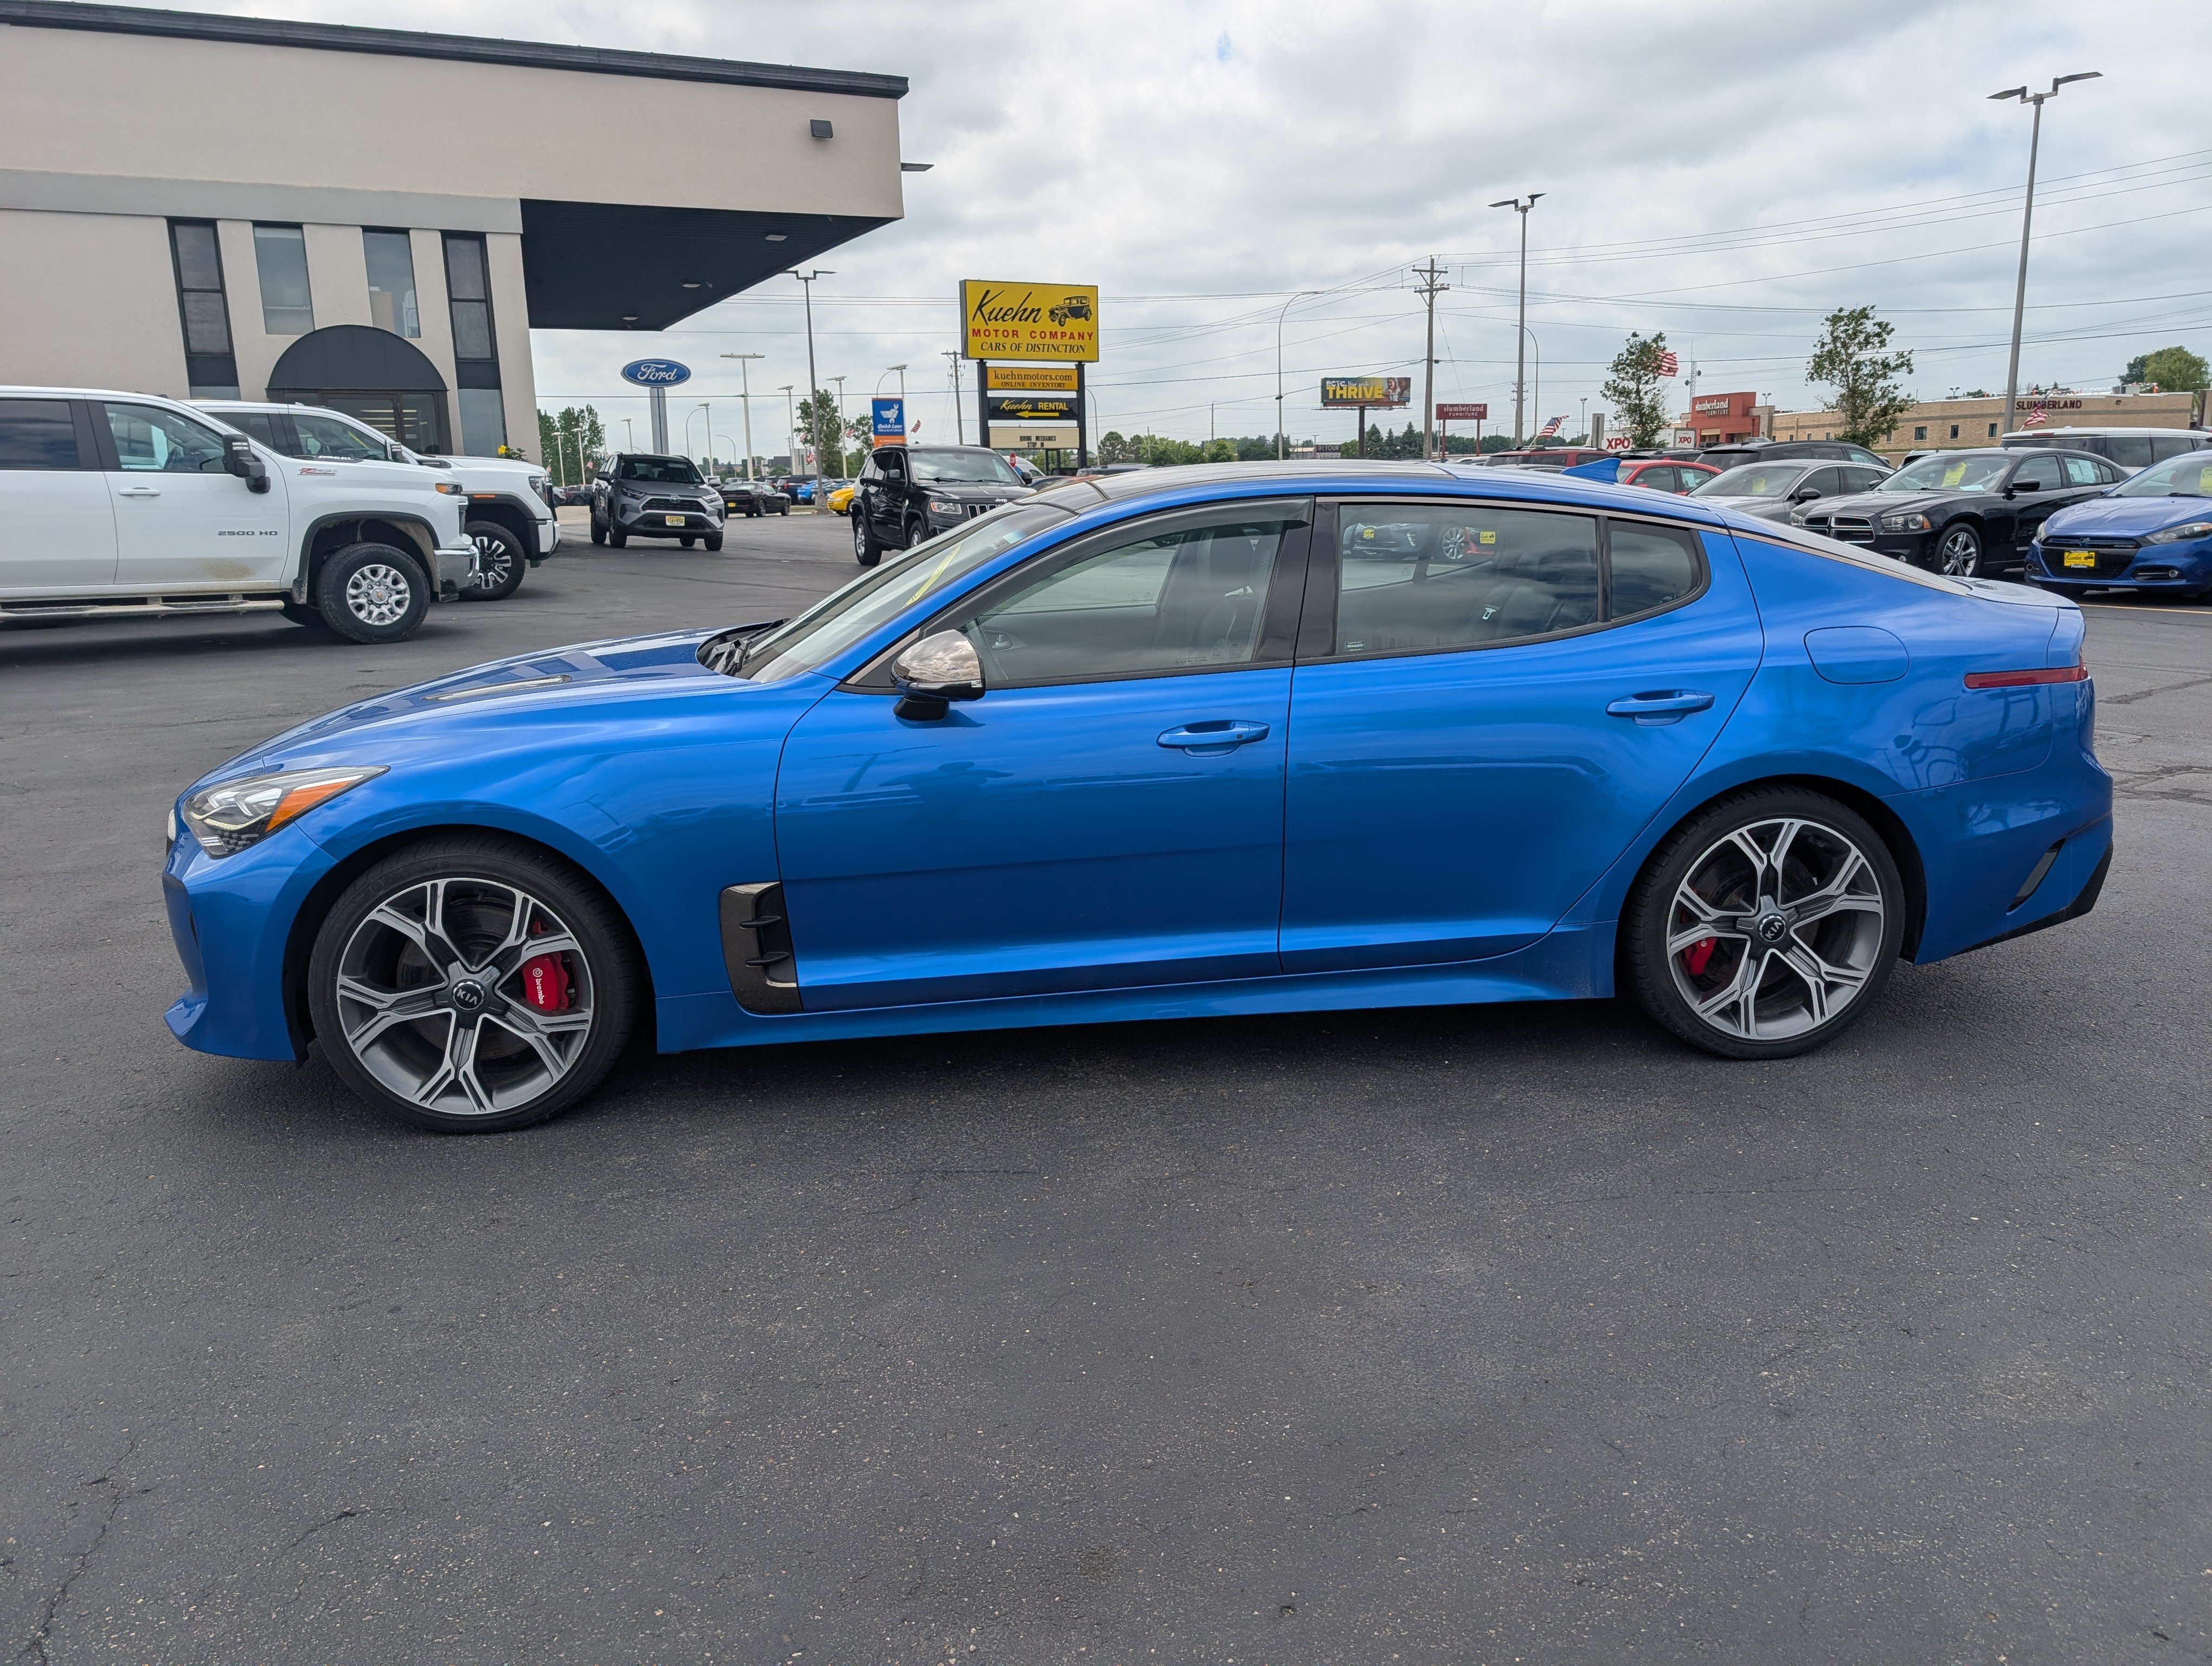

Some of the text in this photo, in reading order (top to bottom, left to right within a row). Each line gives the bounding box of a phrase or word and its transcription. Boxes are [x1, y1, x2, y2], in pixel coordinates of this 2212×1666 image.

[972, 289, 1043, 326] Kuehn
[972, 328, 1094, 341] MOTOR COMPANY
[980, 342, 1086, 354] CARS OF DISTINCTION
[637, 363, 678, 380] Ford
[994, 370, 1072, 381] kuehnmotors.com
[1000, 399, 1069, 411] Kuehn RENTAL
[1606, 437, 1630, 450] XPO
[1765, 921, 1783, 939] KIA
[456, 989, 478, 1005] KIA
[536, 978, 545, 1004] brembo
